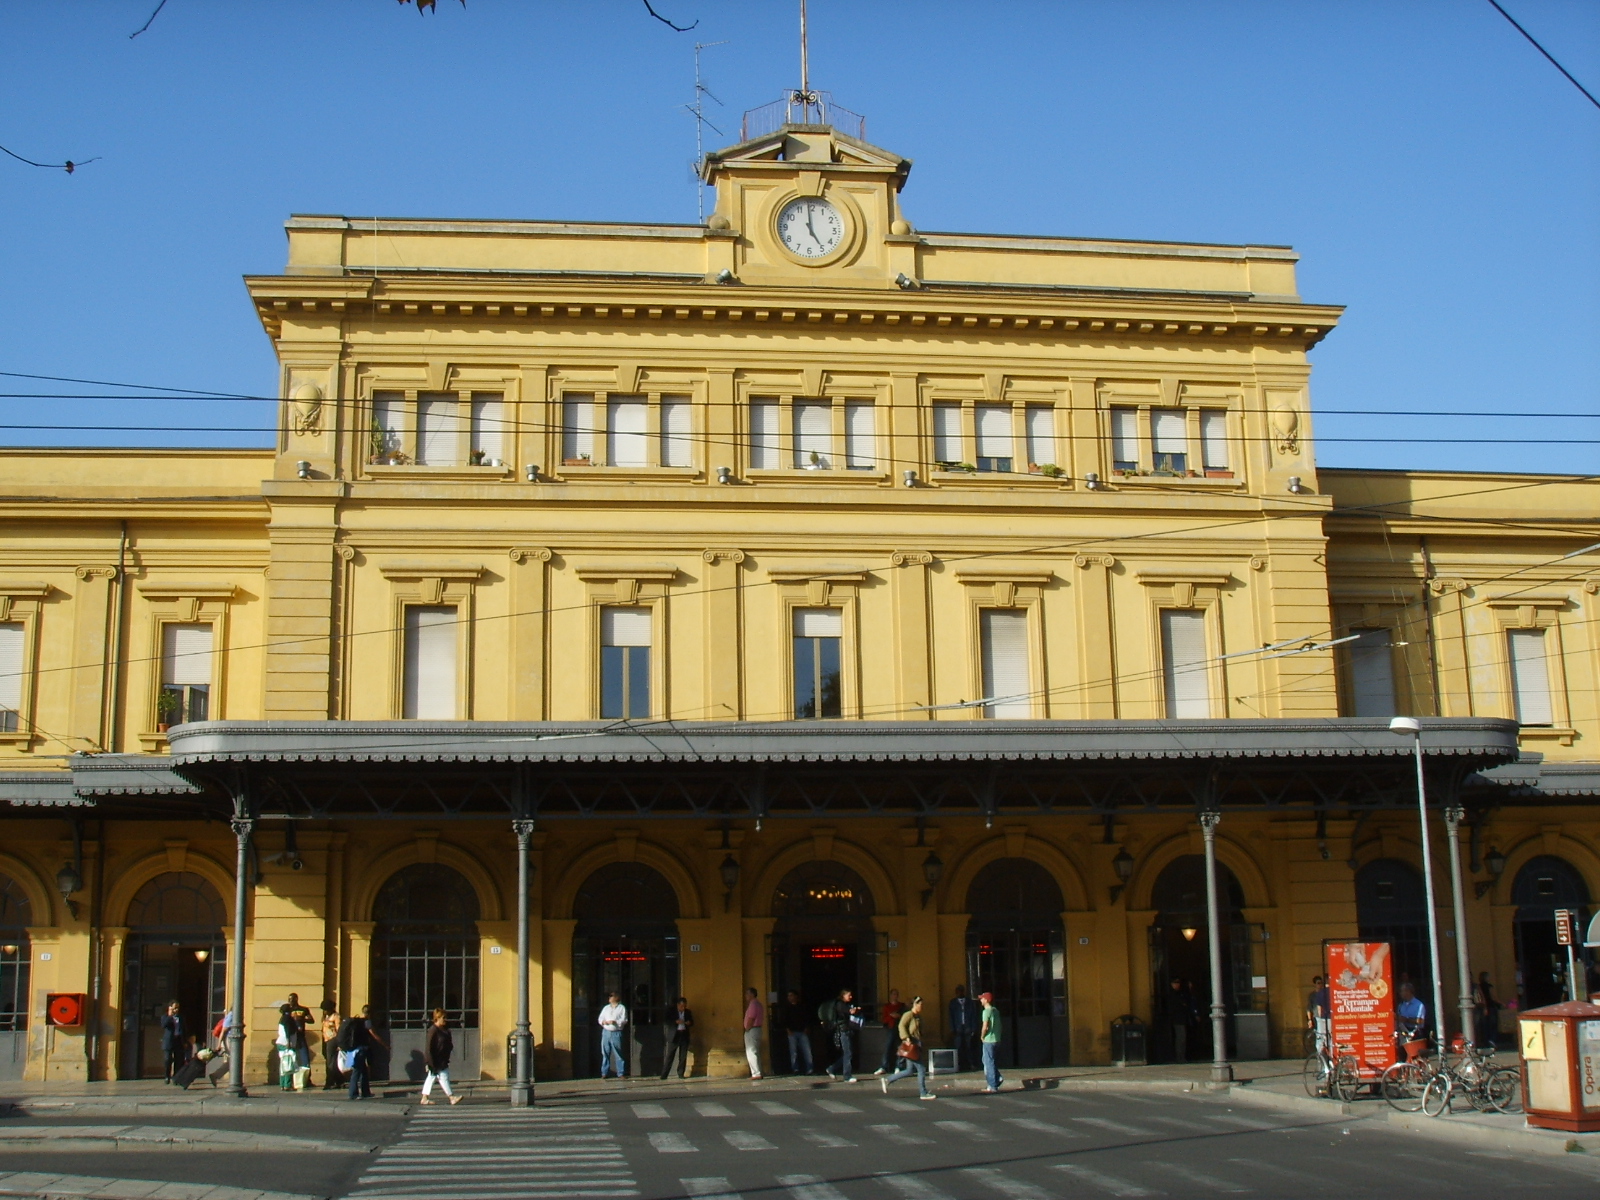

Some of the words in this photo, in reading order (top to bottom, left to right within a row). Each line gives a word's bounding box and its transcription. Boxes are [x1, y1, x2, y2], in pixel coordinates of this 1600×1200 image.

[829, 216, 834, 224] 2
[783, 224, 788, 232] 9
[786, 235, 792, 243] 8
[820, 244, 825, 252] 5
[1345, 1004, 1374, 1012] Montale
[1527, 1031, 1537, 1048] i
[1584, 1056, 1594, 1094] Opera
